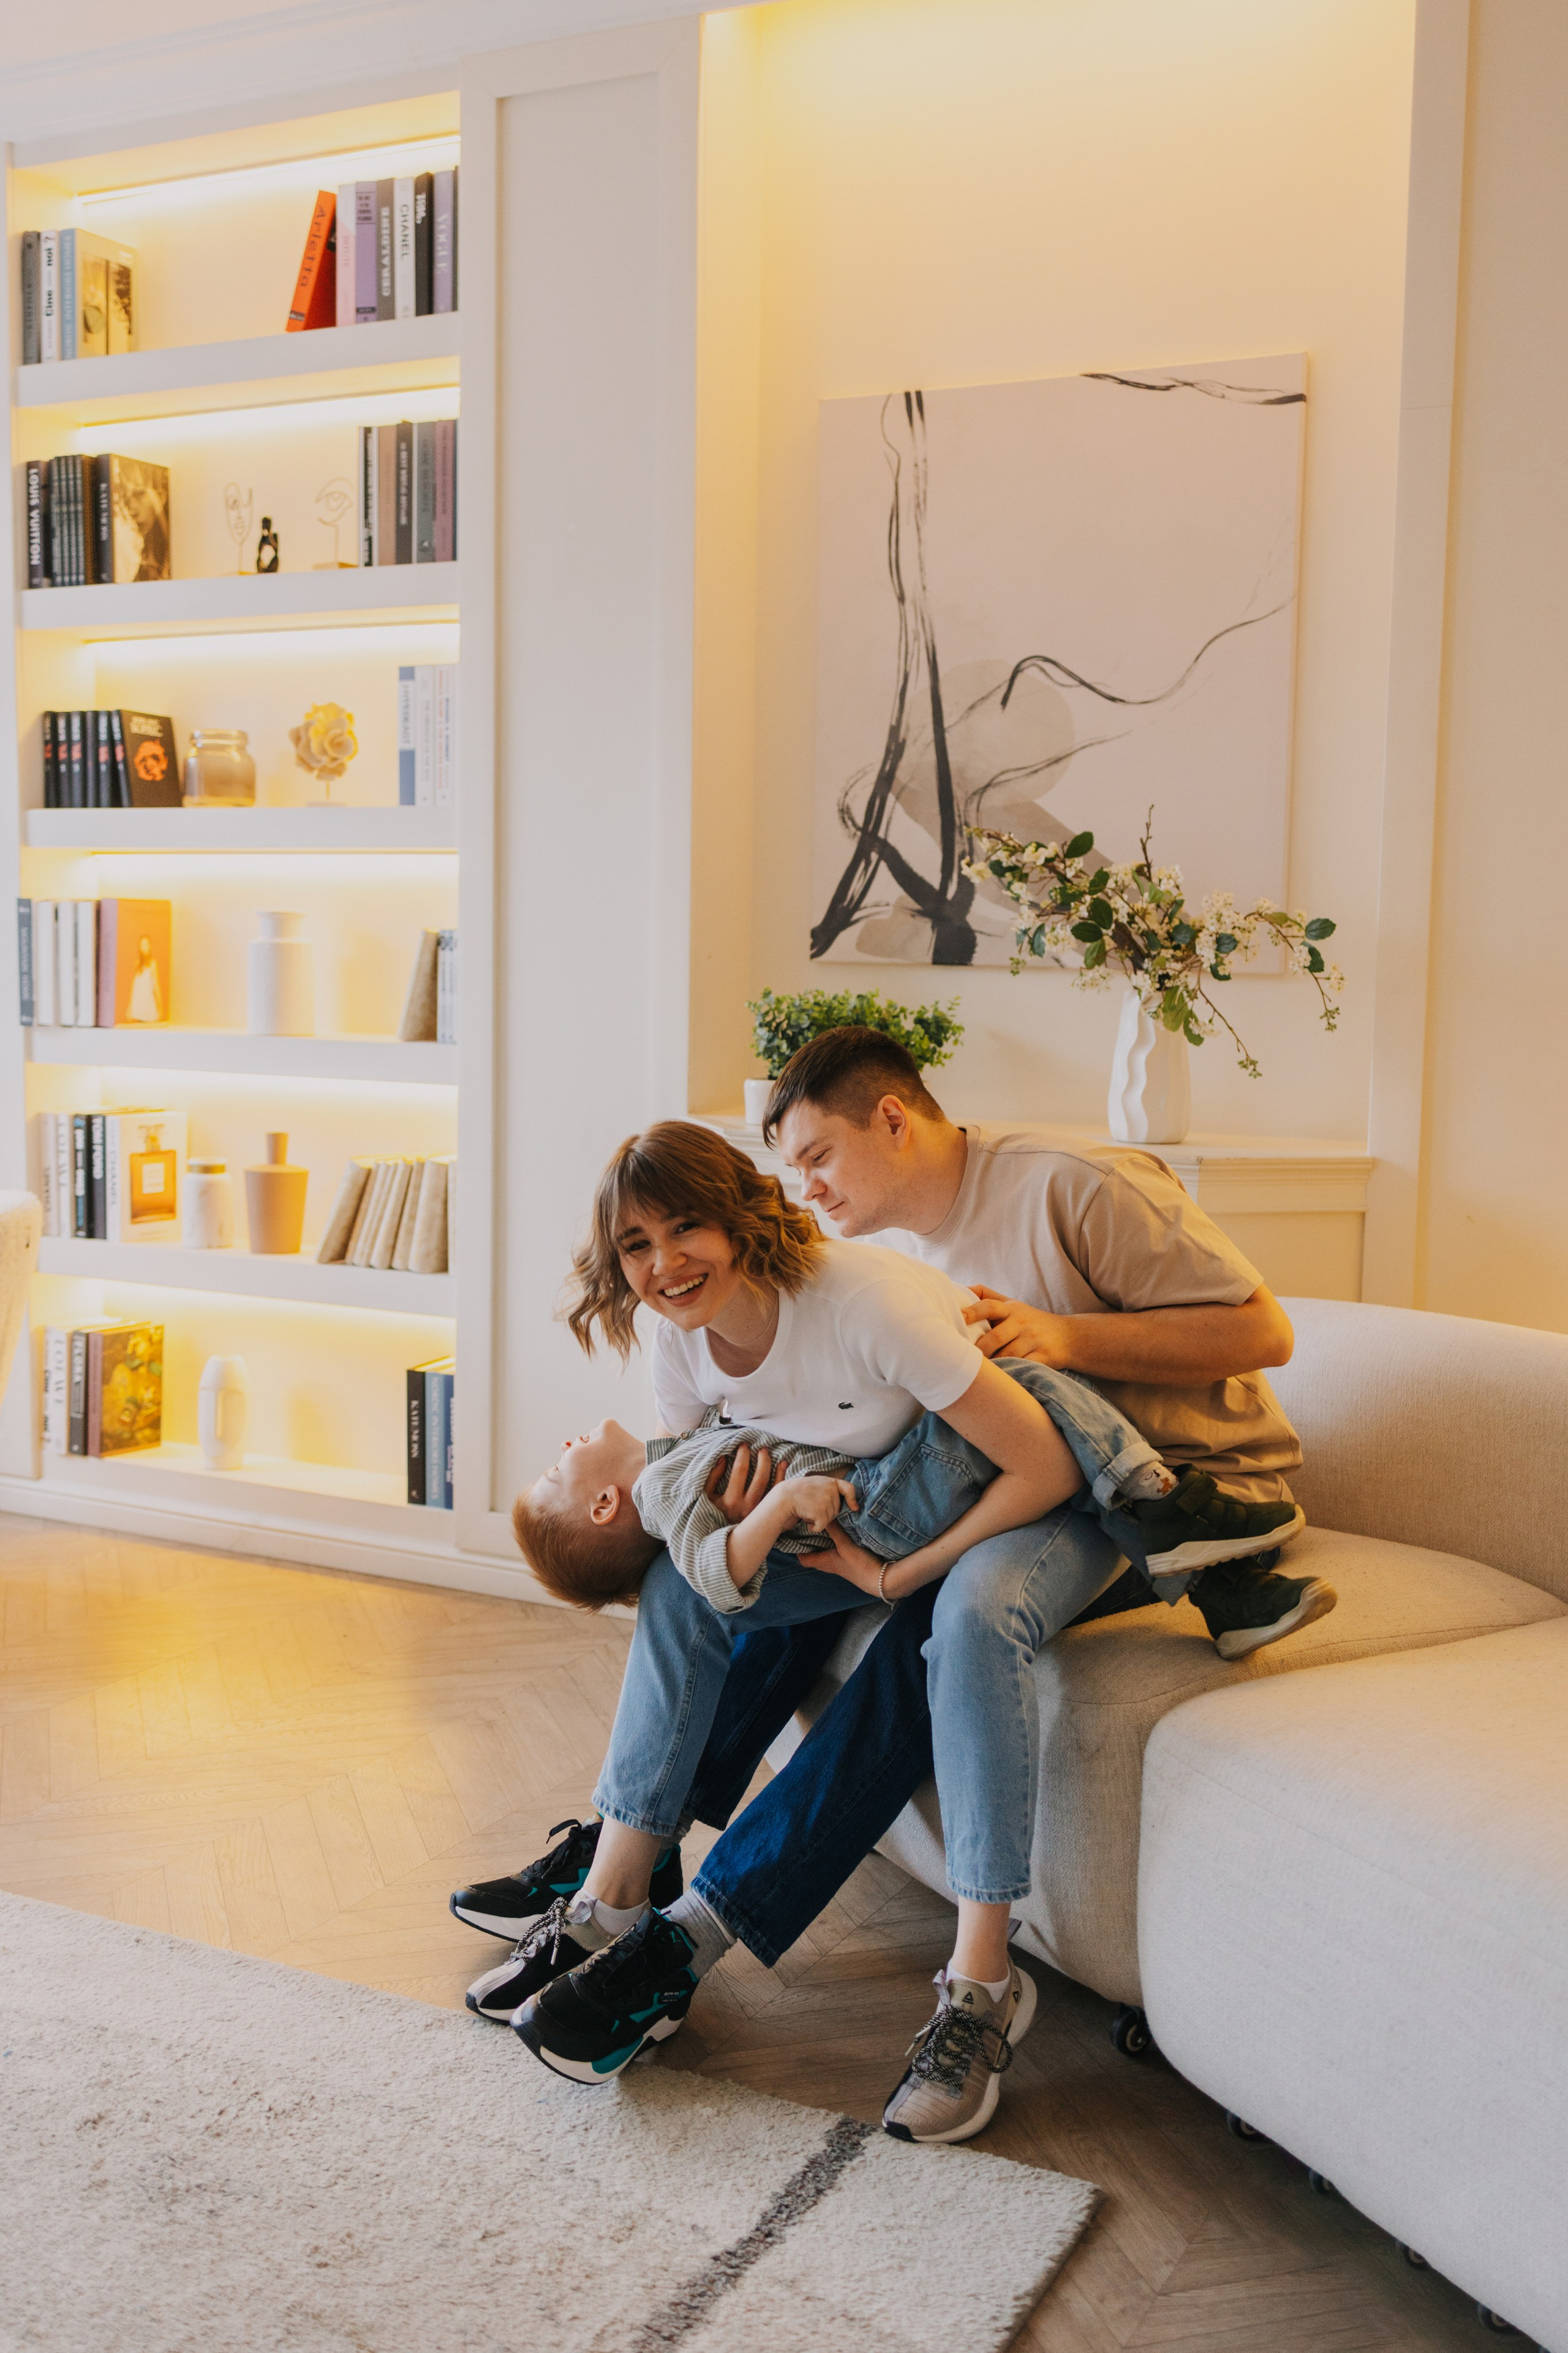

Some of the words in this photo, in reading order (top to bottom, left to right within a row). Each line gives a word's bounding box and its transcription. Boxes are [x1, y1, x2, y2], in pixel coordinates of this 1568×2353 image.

[380, 206, 391, 296] GERALDINE
[400, 203, 410, 262] CHANEL
[29, 469, 40, 506] LOUIS
[29, 509, 41, 565] VUITTON
[92, 1116, 104, 1144] TOM
[92, 1144, 104, 1180] FORD
